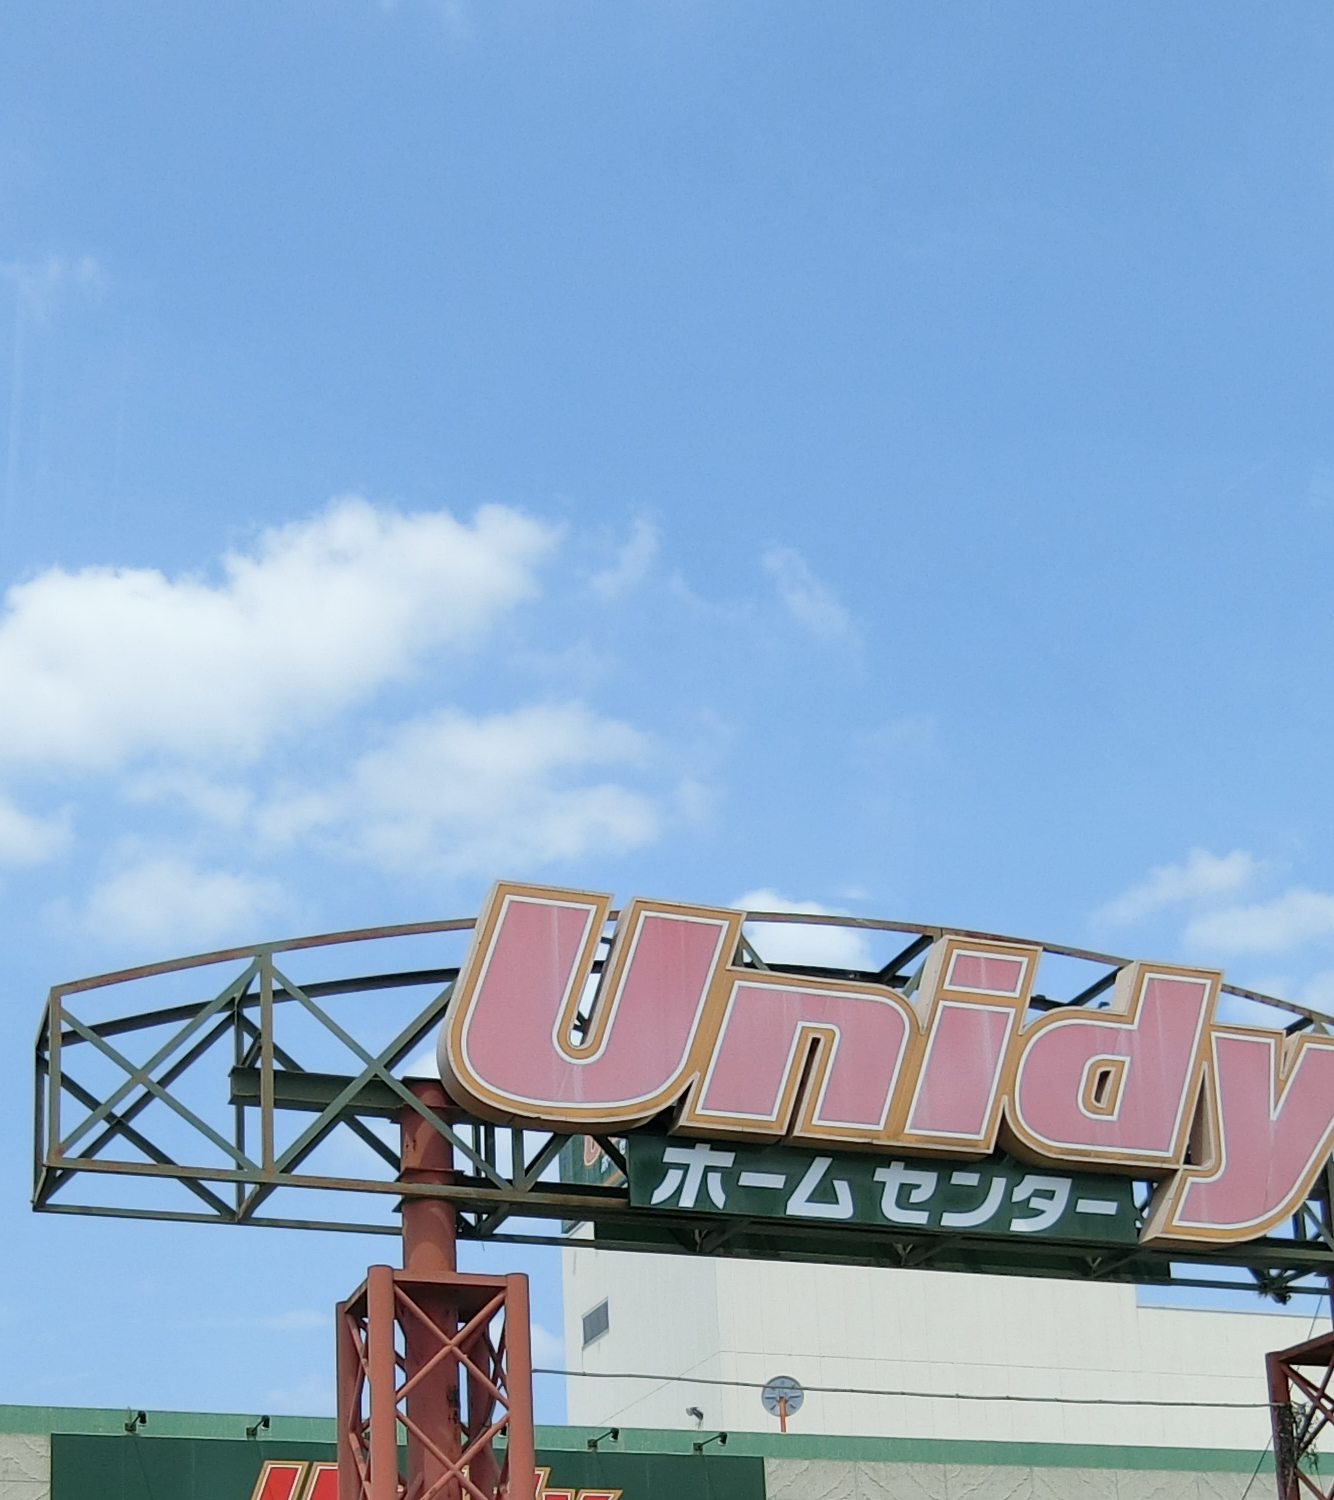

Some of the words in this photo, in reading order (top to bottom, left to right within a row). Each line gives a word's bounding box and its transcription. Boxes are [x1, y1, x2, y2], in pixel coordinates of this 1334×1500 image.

[651, 1142, 1119, 1233] ホームセンター
